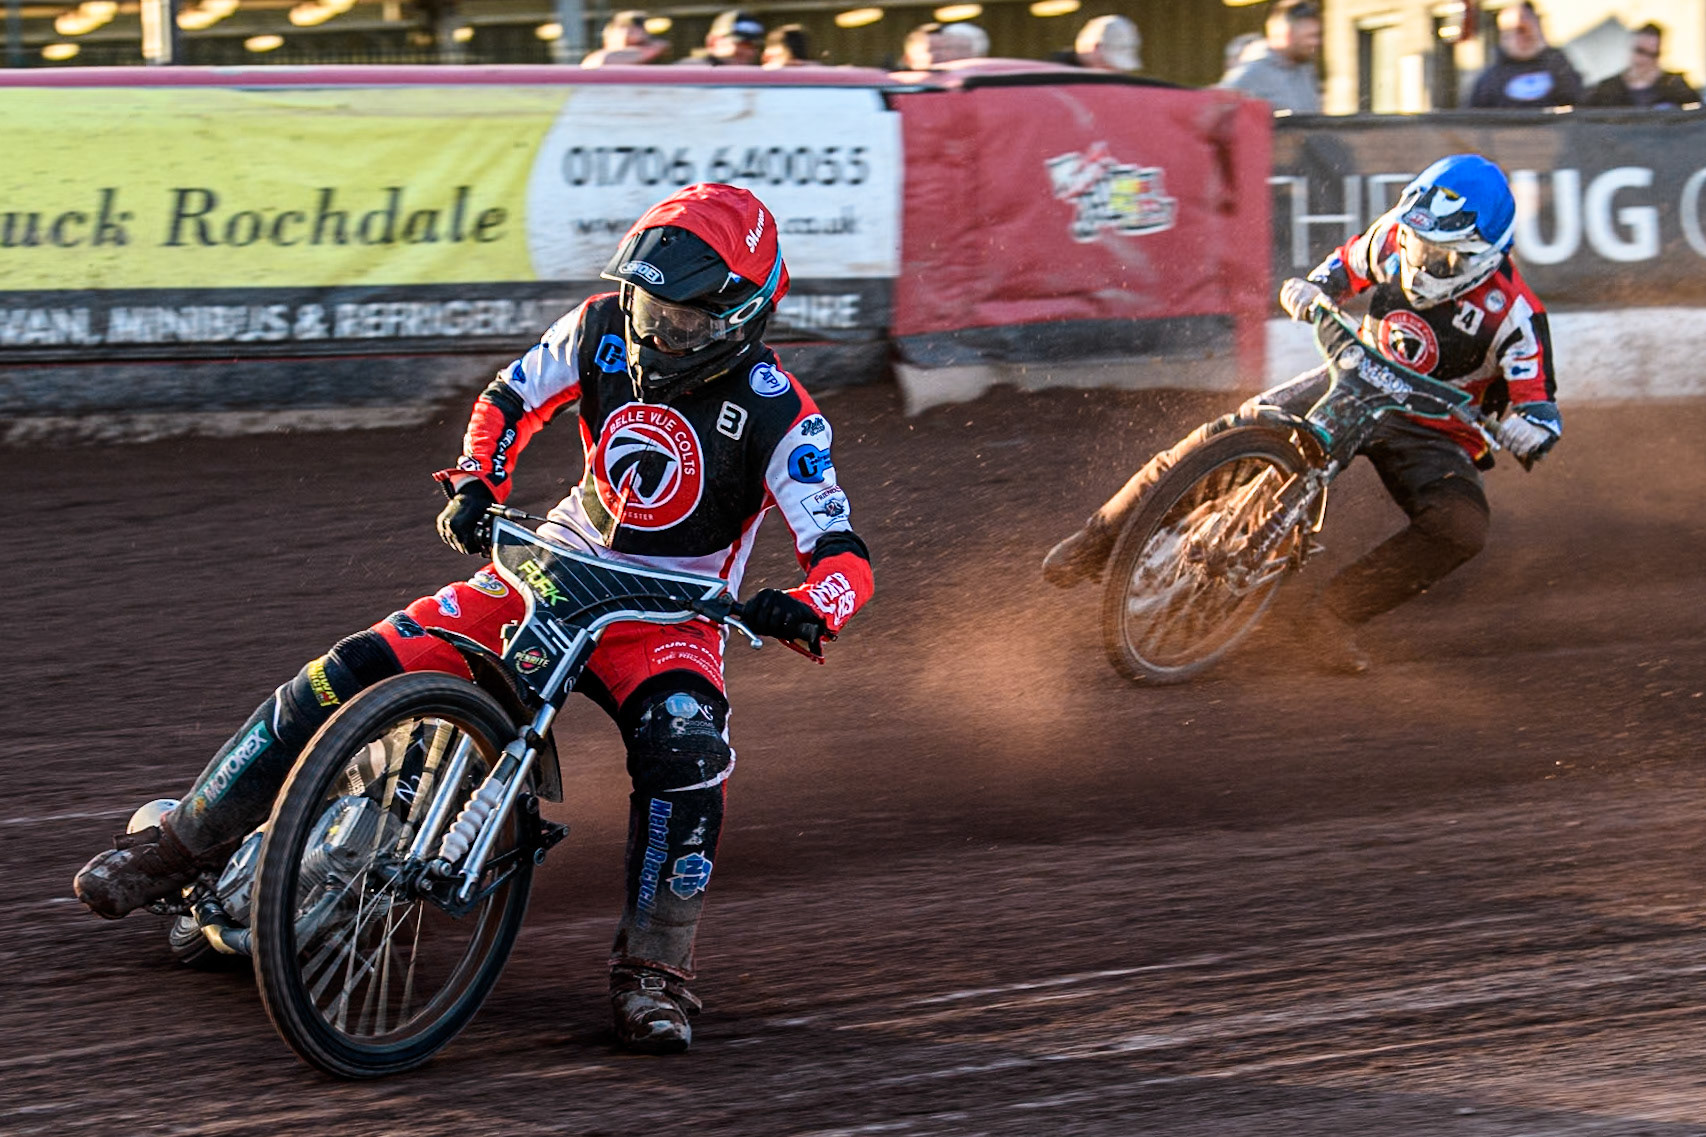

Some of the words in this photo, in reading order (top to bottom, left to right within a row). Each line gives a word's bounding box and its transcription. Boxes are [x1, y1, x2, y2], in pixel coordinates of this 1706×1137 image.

[562, 147, 695, 186] 01706
[708, 147, 869, 186] 640055
[163, 186, 508, 248] Rochdale
[1510, 166, 1661, 265] UG
[1461, 309, 1476, 330] 4
[609, 411, 645, 434] BELLE
[650, 411, 677, 432] VUE
[674, 431, 696, 476] COLTS
[719, 405, 743, 435] 3
[517, 560, 569, 607] FORK
[653, 641, 687, 653] MUM
[203, 728, 267, 803] MOTOREX
[648, 797, 673, 851] Metal
